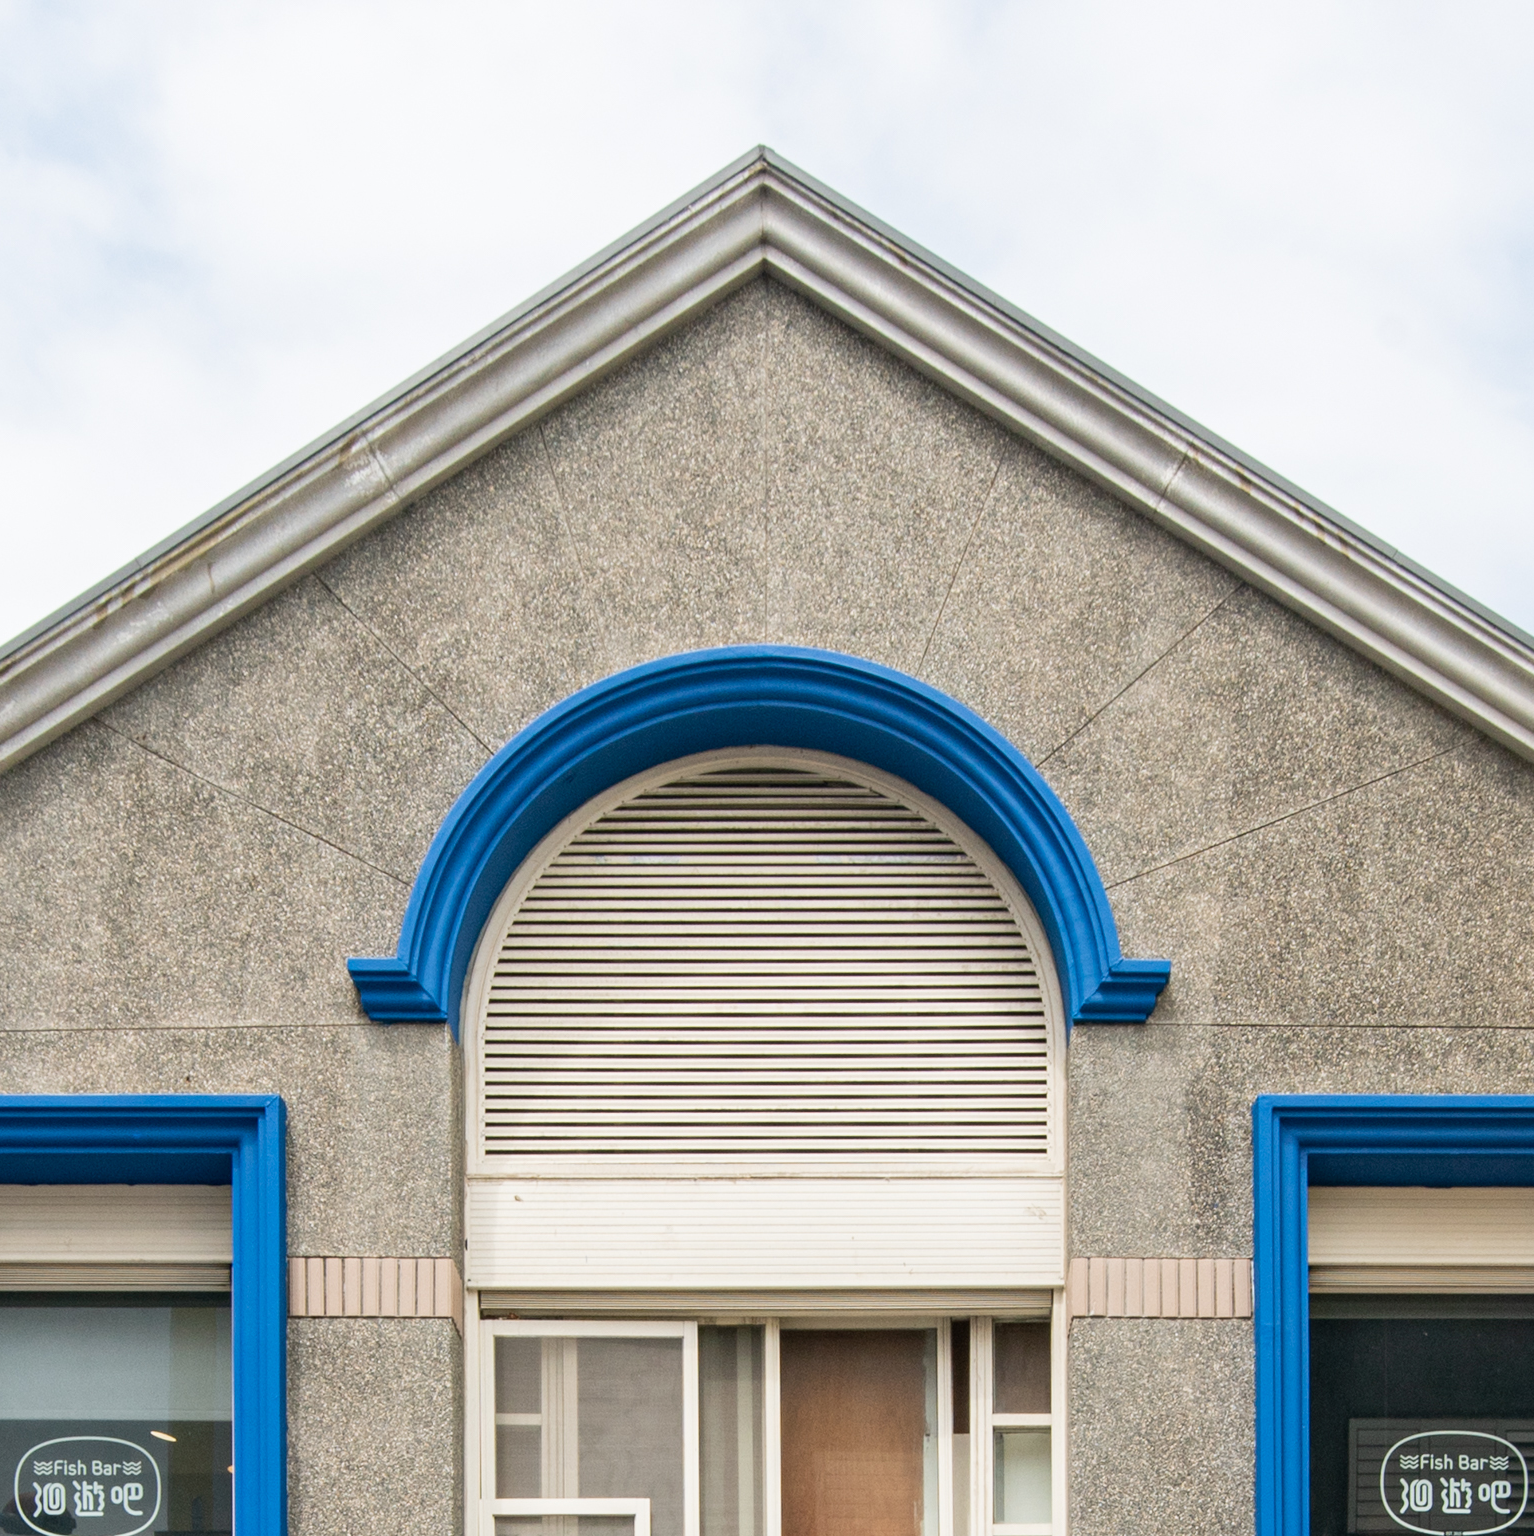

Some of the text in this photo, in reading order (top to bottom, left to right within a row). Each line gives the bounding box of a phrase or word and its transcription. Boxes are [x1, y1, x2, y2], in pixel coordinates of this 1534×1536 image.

[54, 1459, 121, 1476] Fish Bar
[1420, 1453, 1488, 1470] Fish Bar
[33, 1480, 143, 1518] 洄遊吧
[1399, 1477, 1511, 1514] 洄遊吧
